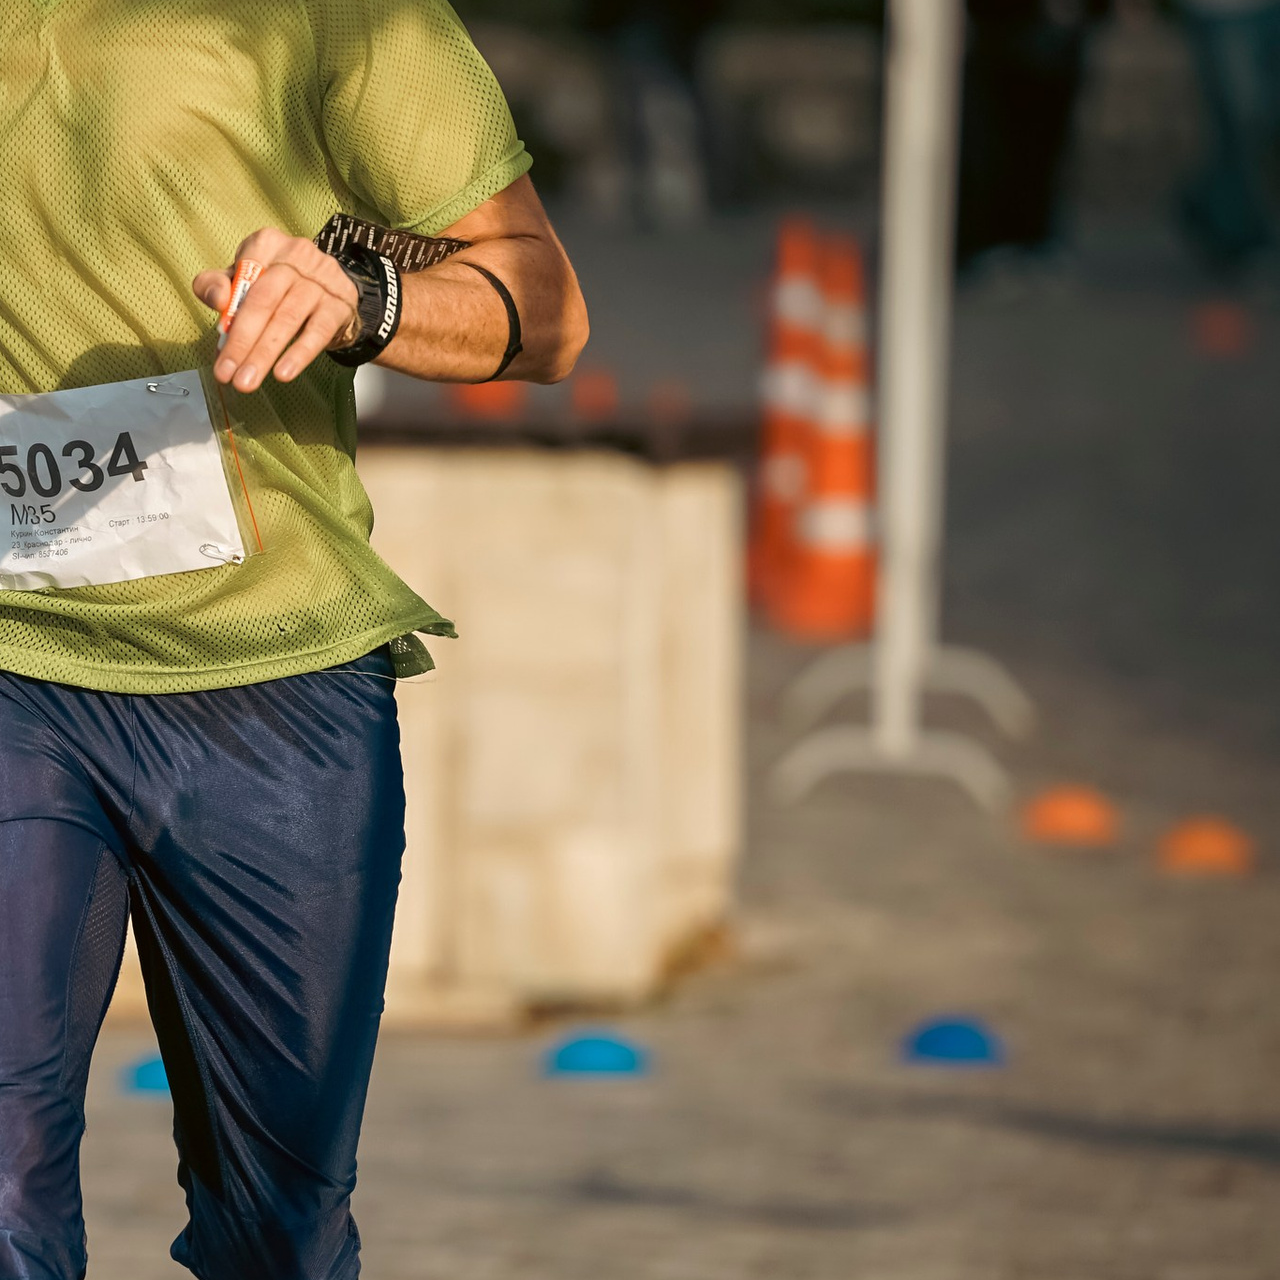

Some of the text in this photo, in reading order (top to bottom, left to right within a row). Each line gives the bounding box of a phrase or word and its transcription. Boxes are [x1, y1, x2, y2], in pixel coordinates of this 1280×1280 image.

[377, 256, 398, 340] noname
[10, 503, 56, 525] M35
[108, 519, 130, 528] Старт
[34, 526, 79, 537] Константин
[69, 536, 93, 544] лично
